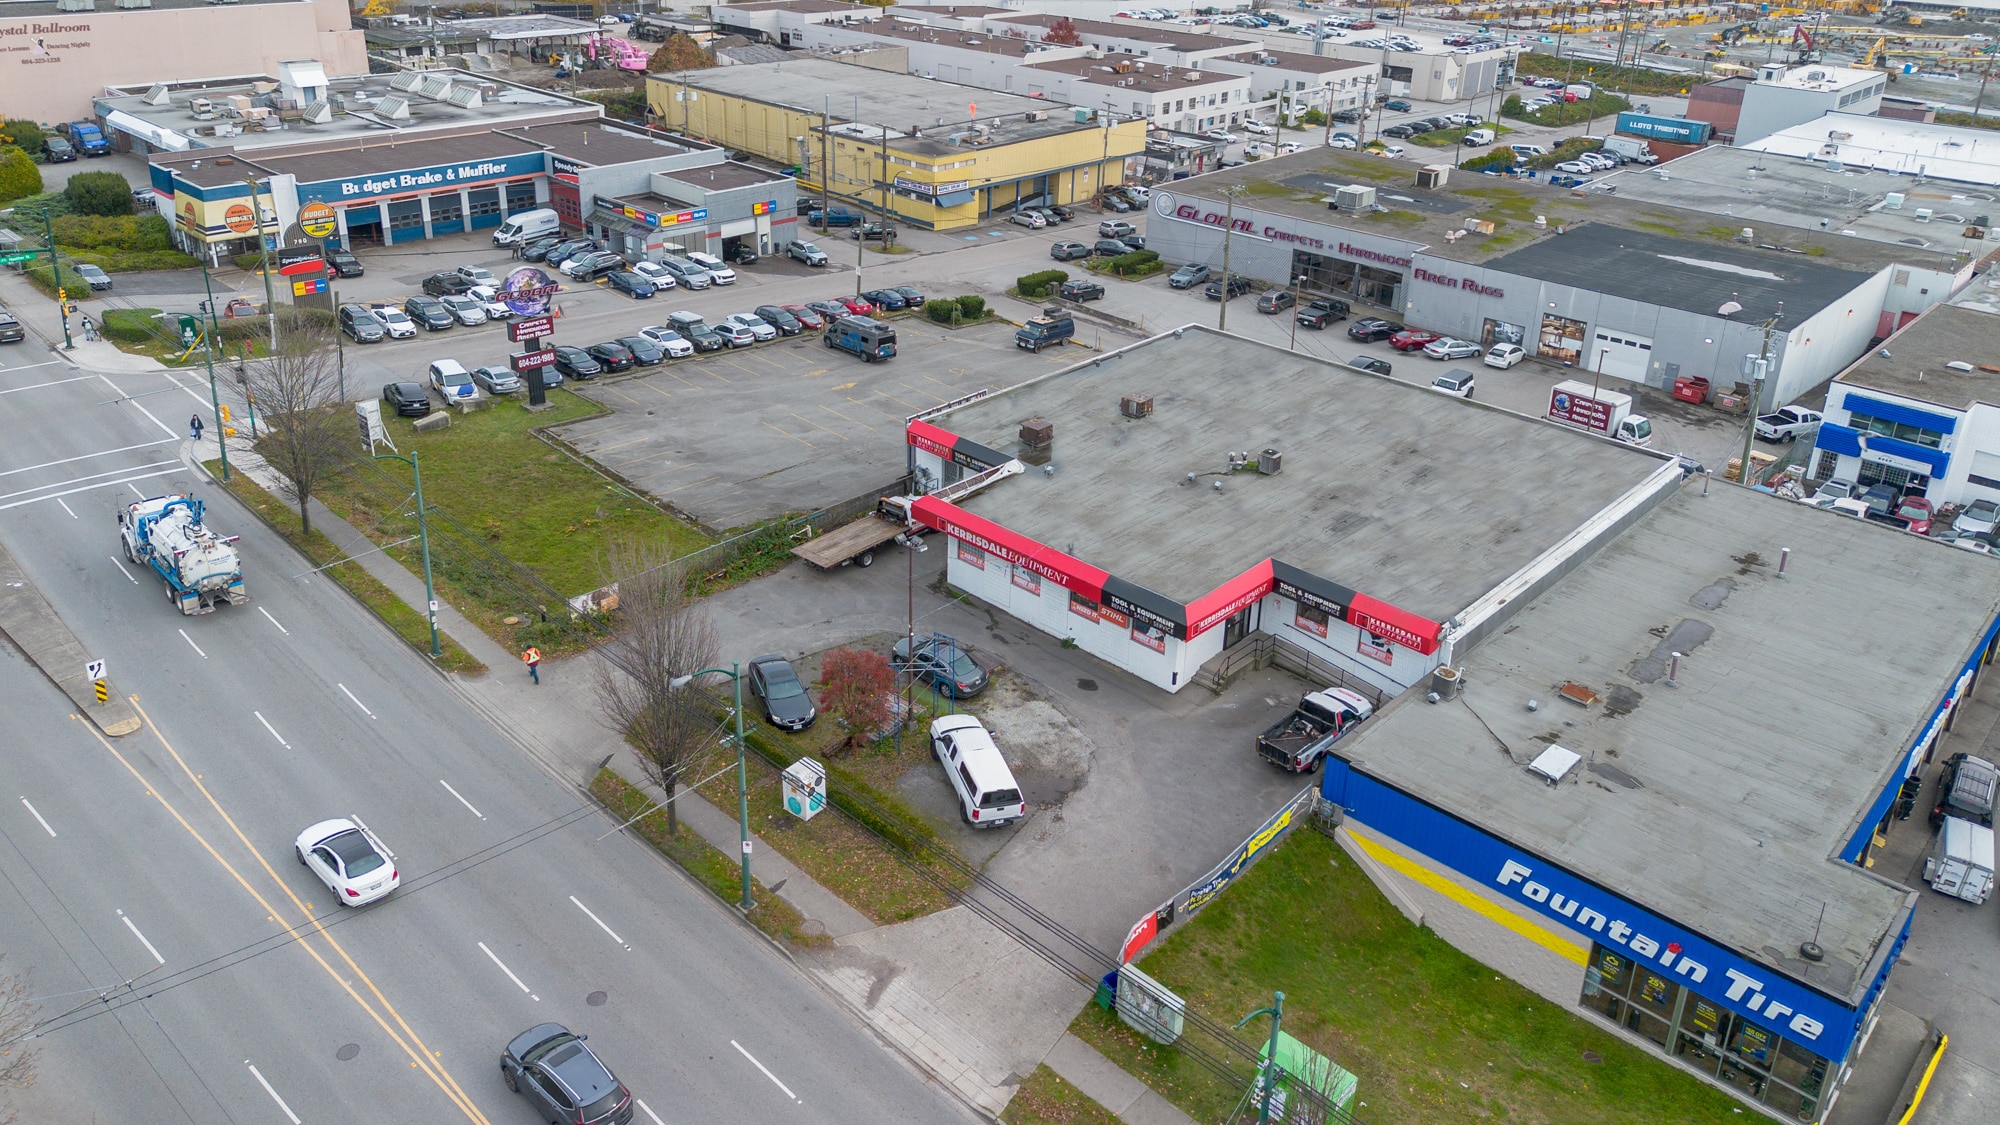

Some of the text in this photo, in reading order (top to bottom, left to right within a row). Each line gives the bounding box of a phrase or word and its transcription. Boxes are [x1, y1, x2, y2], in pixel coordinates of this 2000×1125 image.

[0, 22, 91, 38] ystal Ballroom
[1630, 121, 1651, 130] LLOYD
[400, 171, 442, 187] Brake
[446, 168, 455, 180] &
[458, 162, 507, 178] Muffler
[226, 214, 253, 224] BUDGET
[304, 209, 330, 218] BUDGET
[1176, 205, 1258, 234] GLOBAL
[1264, 226, 1324, 249] CARPETS
[1414, 268, 1504, 298] AREA RUGS
[495, 284, 563, 302] GLOBAL
[516, 324, 550, 335] HARDWOOD
[518, 318, 547, 328] CARPETS
[517, 329, 551, 341] AREA RUGS
[519, 352, 554, 368] 604-222-1988
[947, 523, 1070, 585] KERRISDALE EQUIPMENT
[1280, 582, 1296, 593] TOOL
[1304, 592, 1341, 611] EQUIPMENT
[1076, 605, 1091, 616] NEED
[1100, 607, 1124, 622] STIHL
[1111, 596, 1128, 608] TOOL
[1137, 608, 1175, 629] EQUIPMENT
[1111, 602, 1174, 635] RENTAL SALES SERVICE
[1200, 603, 1235, 627] KERRISDALE
[1320, 604, 1340, 617] SERVICE
[1370, 617, 1422, 642] KERRISDALE
[1371, 624, 1418, 647] EQUIPMENT
[1496, 859, 1824, 1040] Fountain Tire
